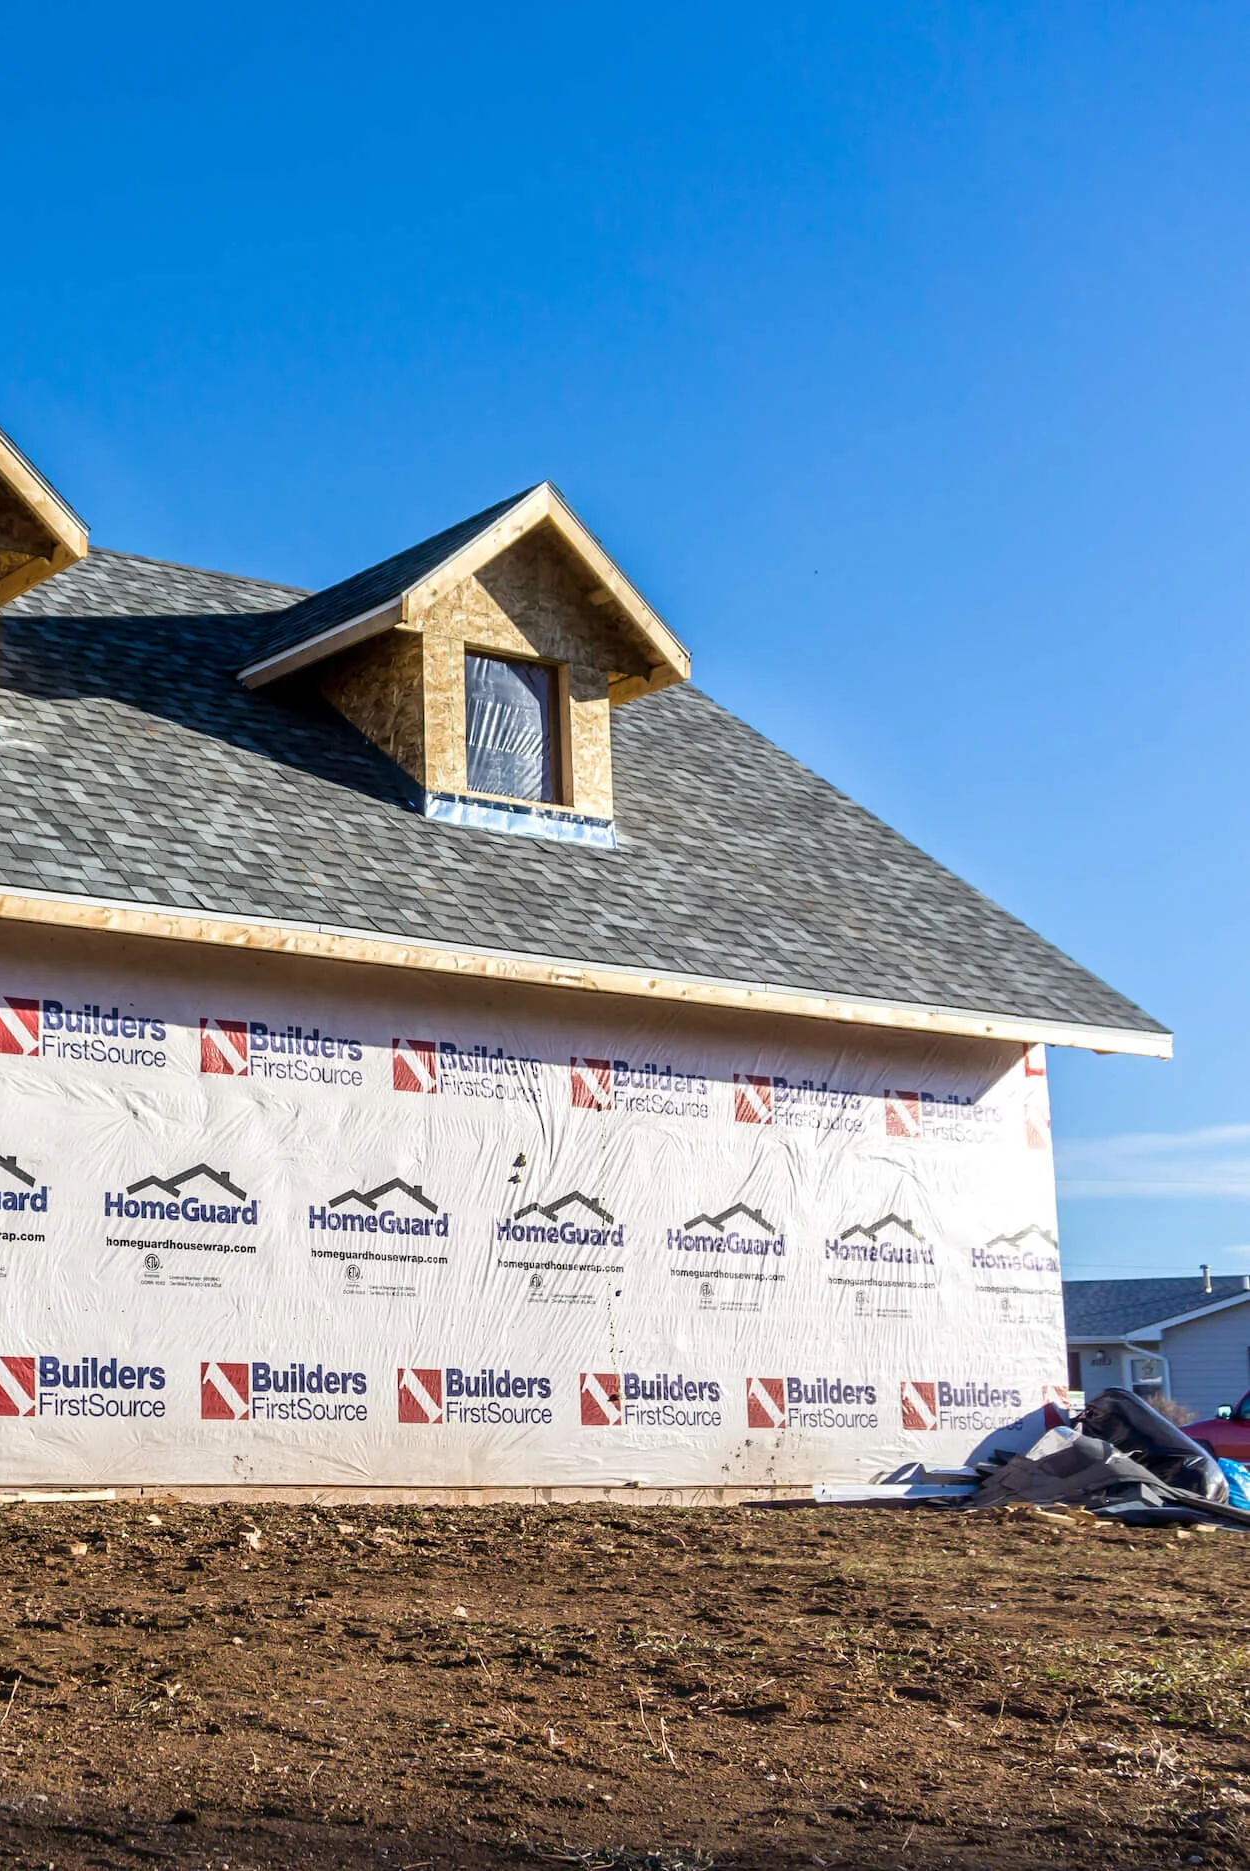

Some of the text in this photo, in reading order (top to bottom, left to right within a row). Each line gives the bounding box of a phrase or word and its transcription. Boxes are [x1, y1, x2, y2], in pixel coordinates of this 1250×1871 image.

[42, 999, 167, 1041] Builders
[42, 1034, 167, 1068] FirstSource
[249, 1022, 363, 1061] Builders
[249, 1055, 363, 1087] FirstSource
[439, 1041, 543, 1079] Builders
[613, 1060, 708, 1095] Builders
[614, 1090, 709, 1119] FirstSource
[773, 1076, 862, 1110] Builders
[104, 1191, 258, 1225] HomeGuard
[309, 1205, 449, 1237] HomeGuard
[106, 1236, 257, 1254] homeguardhousewrap.com
[496, 1217, 625, 1247] HomeGuard
[667, 1228, 786, 1257] HomeGuard
[311, 1248, 448, 1265] homeguardhousewrap.com
[497, 1258, 625, 1273] homeguardhousewrap.com
[39, 1356, 166, 1390] Builders
[252, 1362, 367, 1395] Builders
[446, 1368, 551, 1398] Builders
[624, 1372, 721, 1402] Builders
[39, 1392, 166, 1417] FirstSource
[787, 1377, 877, 1405] Builders
[938, 1381, 1022, 1408] Builders
[252, 1397, 367, 1421] FirstSource
[446, 1401, 552, 1424] FirstSource
[624, 1405, 721, 1426] FirstSource
[788, 1408, 878, 1429] FirstSource
